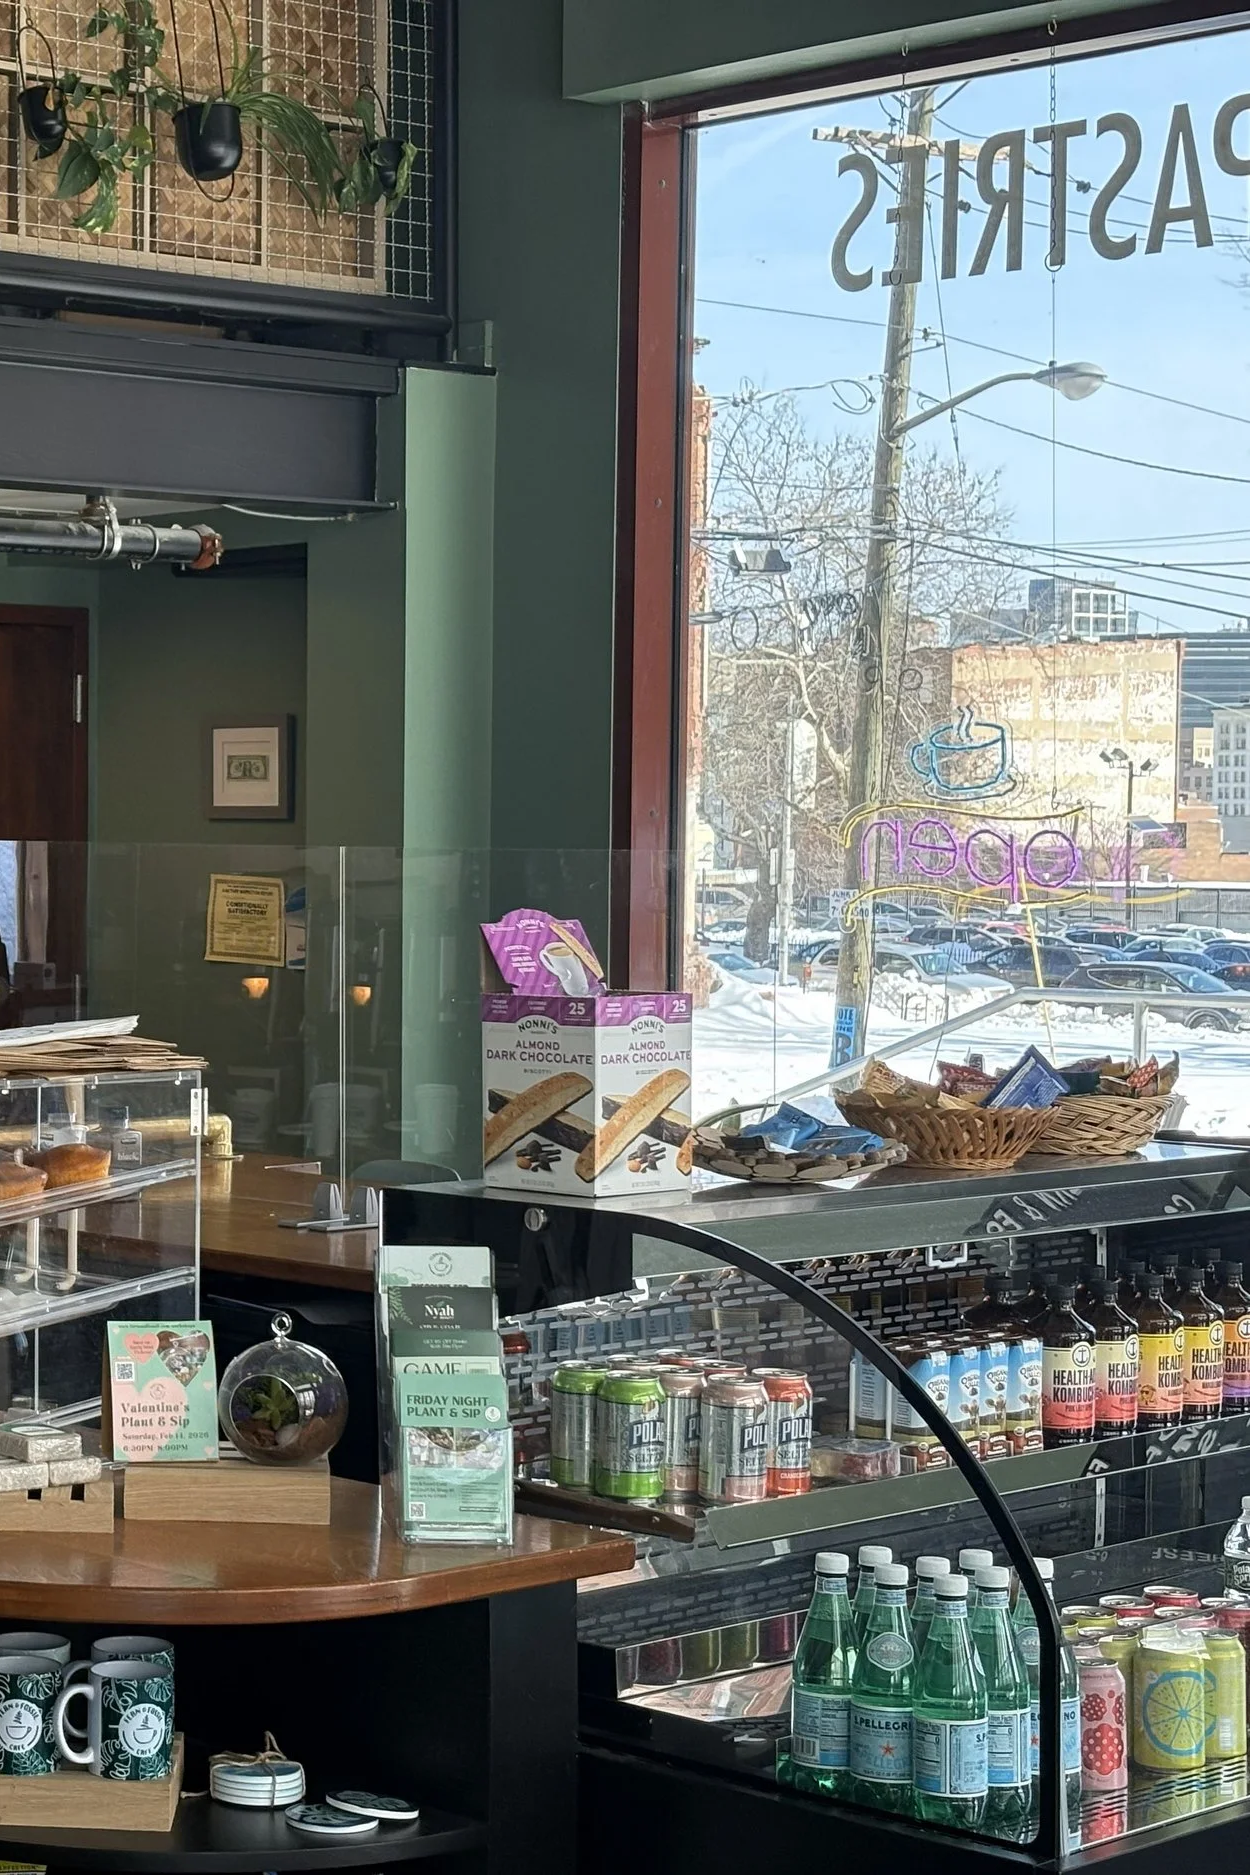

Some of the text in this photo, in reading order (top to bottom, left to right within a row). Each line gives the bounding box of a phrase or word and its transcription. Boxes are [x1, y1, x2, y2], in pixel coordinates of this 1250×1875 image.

[568, 1002, 586, 1015] 25
[672, 1000, 686, 1012] 25
[518, 1019, 559, 1034] NONNI'S
[631, 1019, 665, 1035] NONNI'S
[516, 1041, 560, 1051] ALMOND
[629, 1040, 665, 1051] ALMOND
[486, 1049, 594, 1065] DARK CHOCOLATE
[601, 1050, 691, 1065] DARK CHOCOLATE
[406, 1394, 489, 1407] FRIDAY NIGHT
[121, 1402, 190, 1414] Valentine's
[407, 1406, 481, 1418] PLANT & SIP
[121, 1416, 191, 1429] Plant & Sip
[19, 1702, 39, 1720] FOSSIL
[147, 1706, 163, 1723] FOSSIL
[8, 1743, 25, 1751] CAFE
